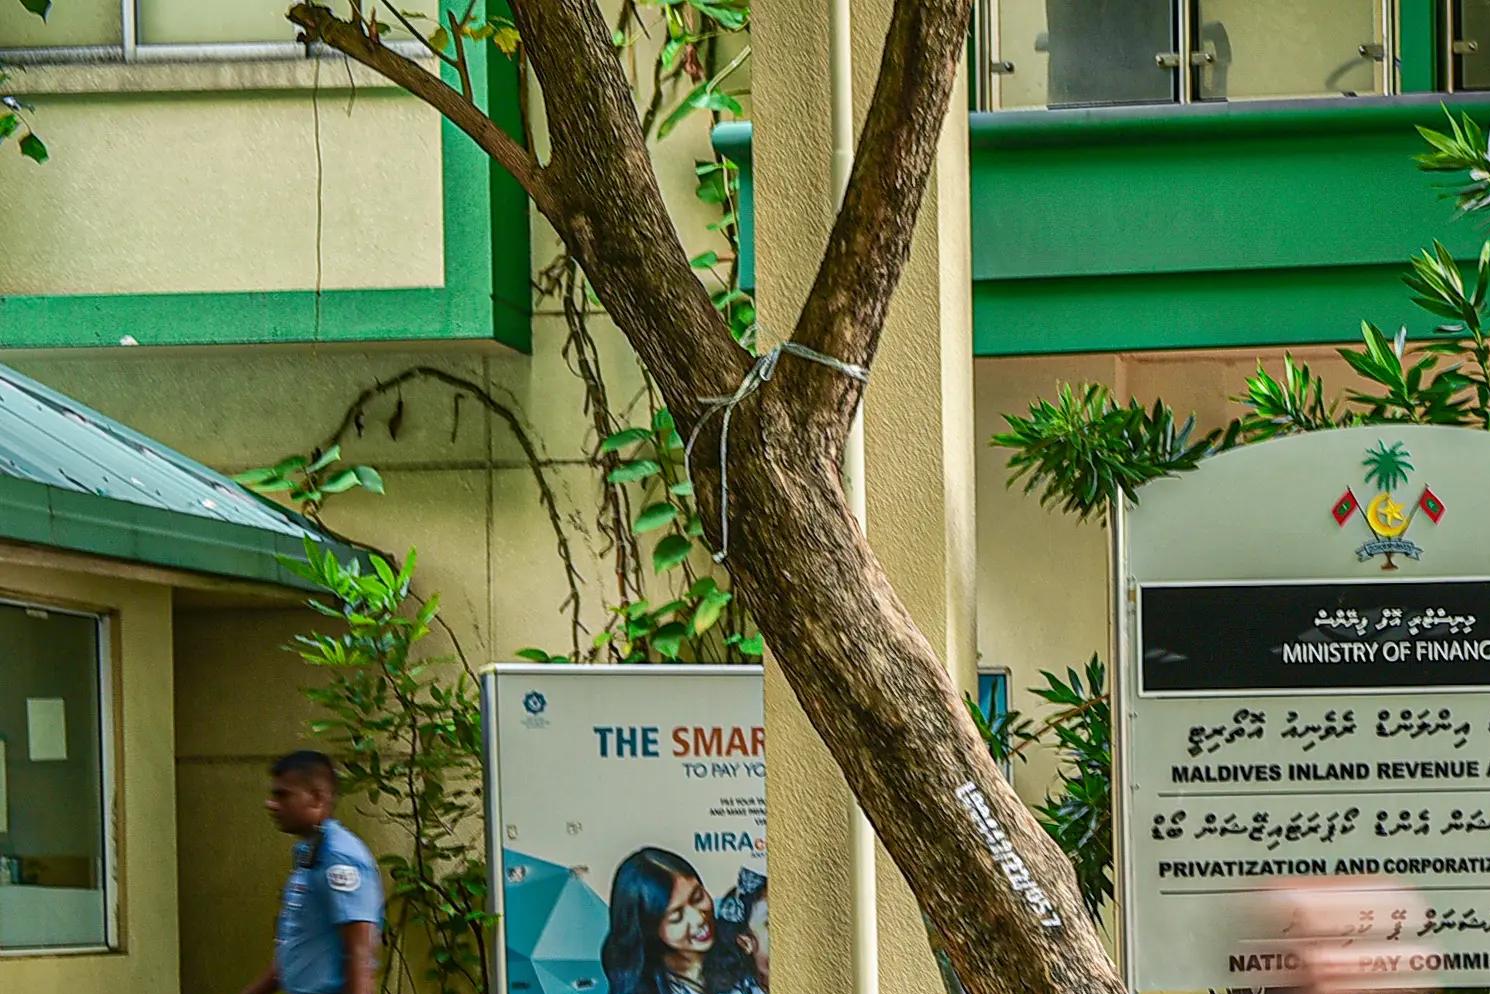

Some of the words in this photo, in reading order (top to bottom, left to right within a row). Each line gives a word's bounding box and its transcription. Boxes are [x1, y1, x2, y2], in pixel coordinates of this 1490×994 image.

[1283, 641, 1379, 663] MINISTRY
[1382, 641, 1411, 662] OF
[593, 727, 660, 758] THE
[683, 763, 707, 778] TO
[711, 762, 740, 778] PAY
[1171, 764, 1282, 783] MALDIVES
[1288, 763, 1370, 781] INLAND
[1376, 761, 1480, 780] REVENUE
[1158, 859, 1327, 878] PRIVATIZATION
[1334, 858, 1380, 876] AND
[1228, 952, 1308, 973] NATIO
[1359, 955, 1401, 973] PAY
